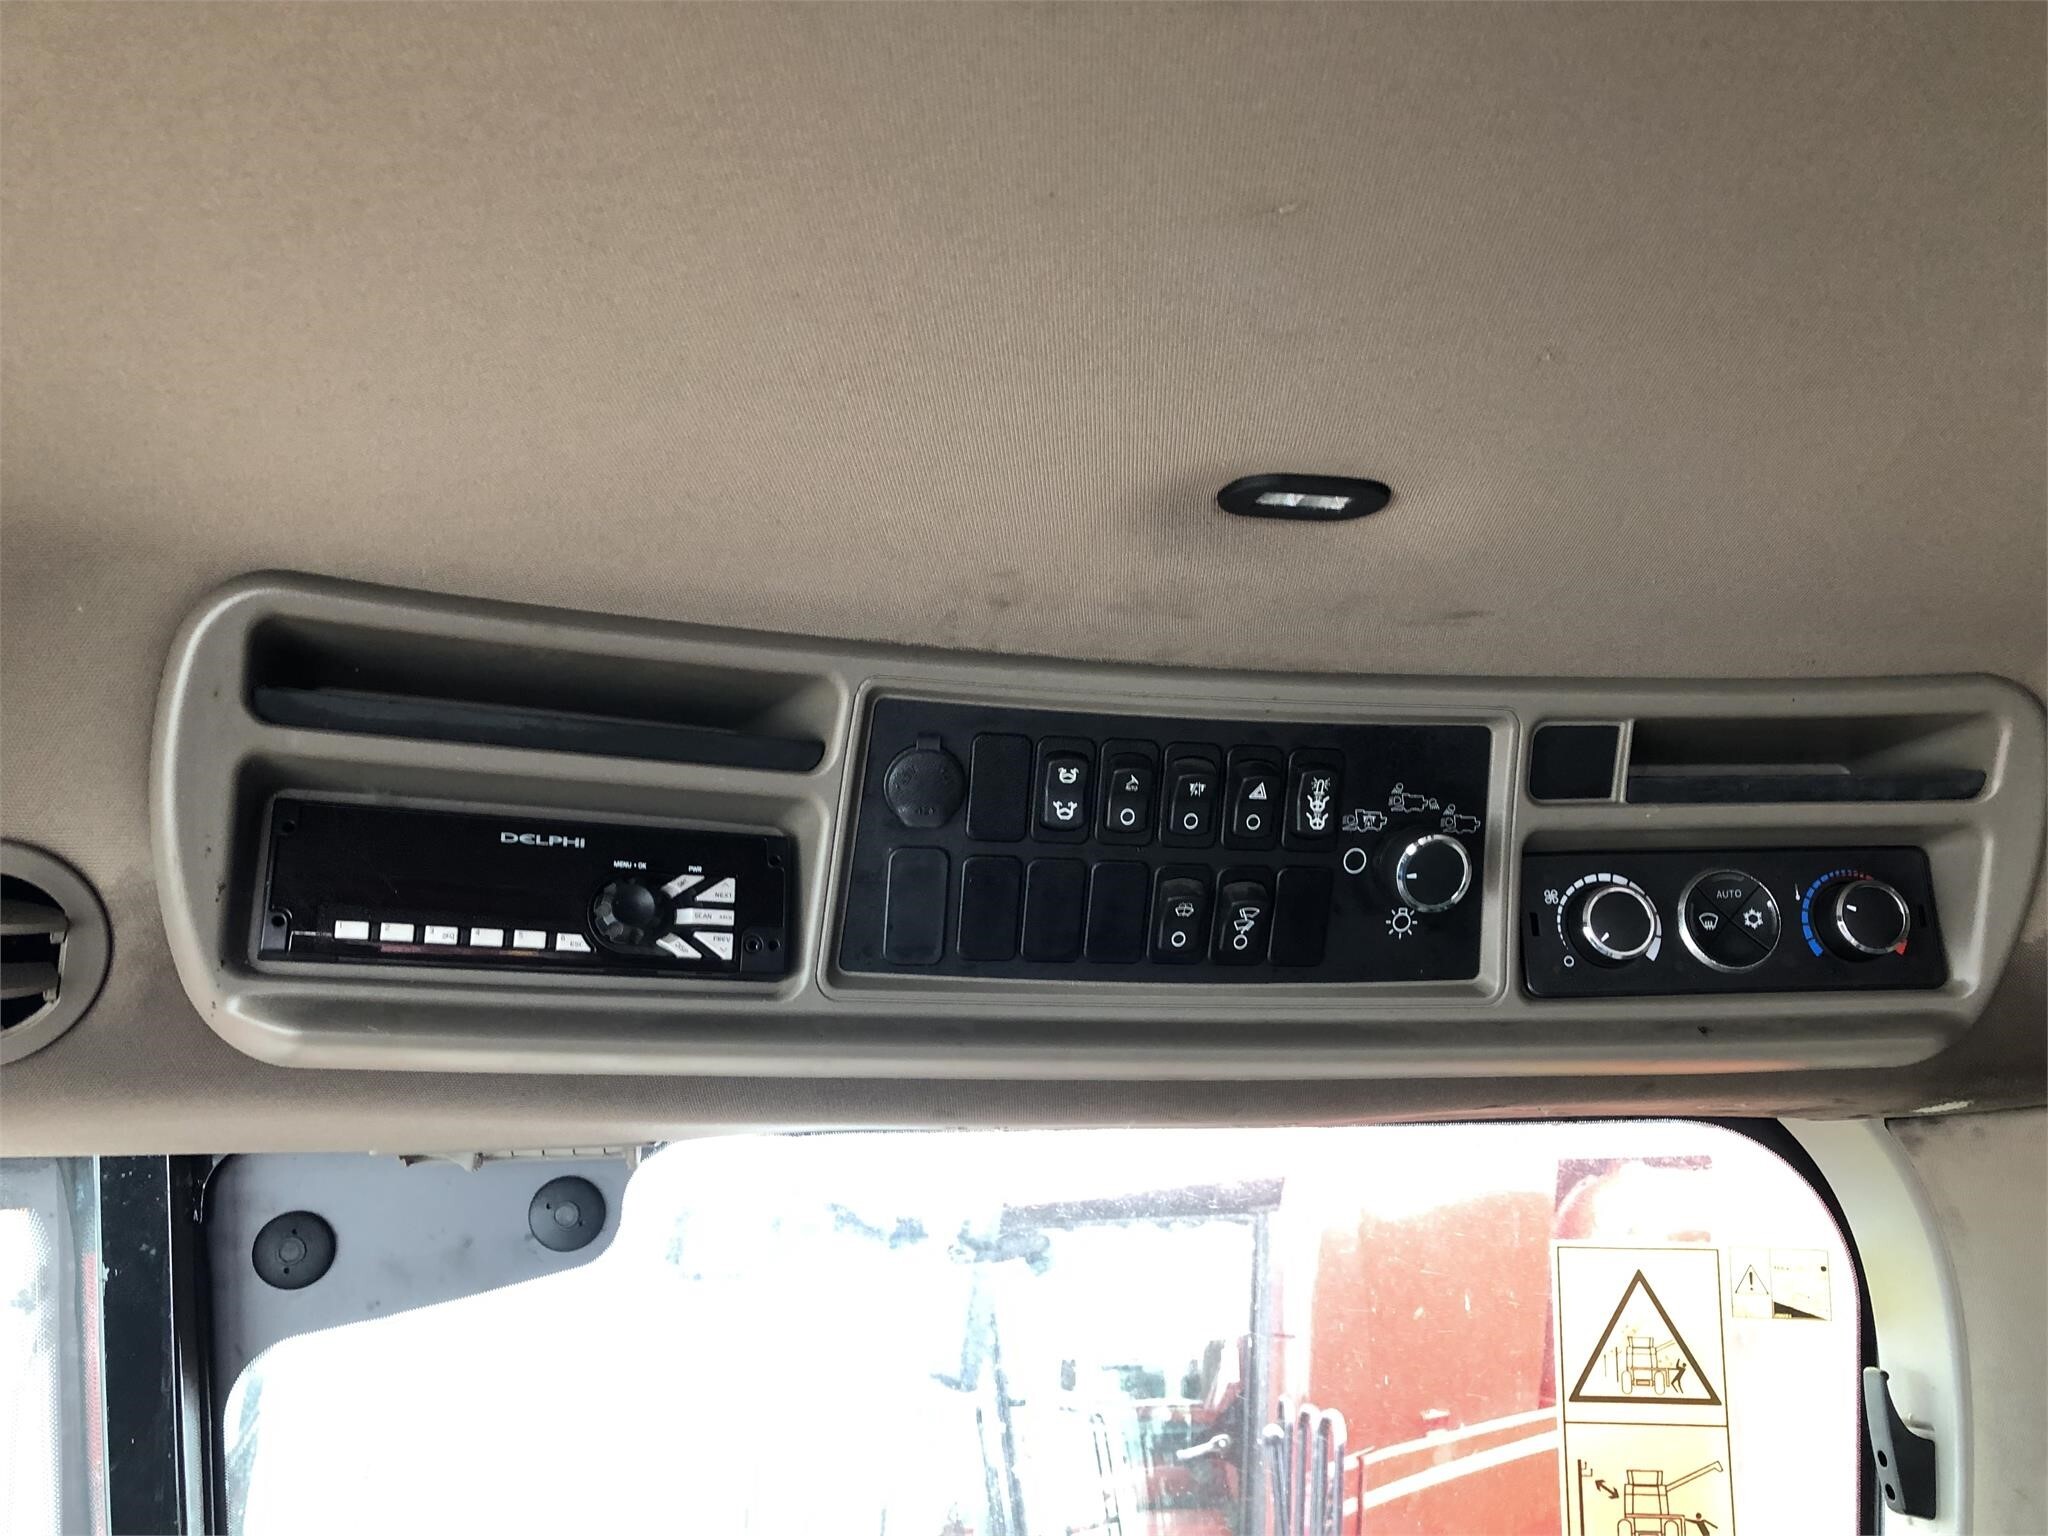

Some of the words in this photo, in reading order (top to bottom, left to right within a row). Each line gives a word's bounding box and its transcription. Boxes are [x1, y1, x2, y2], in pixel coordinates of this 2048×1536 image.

[500, 831, 586, 849] DELPHI
[613, 860, 632, 869] MENU
[637, 861, 647, 870] OK
[1716, 888, 1742, 899] AUTO
[694, 912, 713, 920] SCAN
